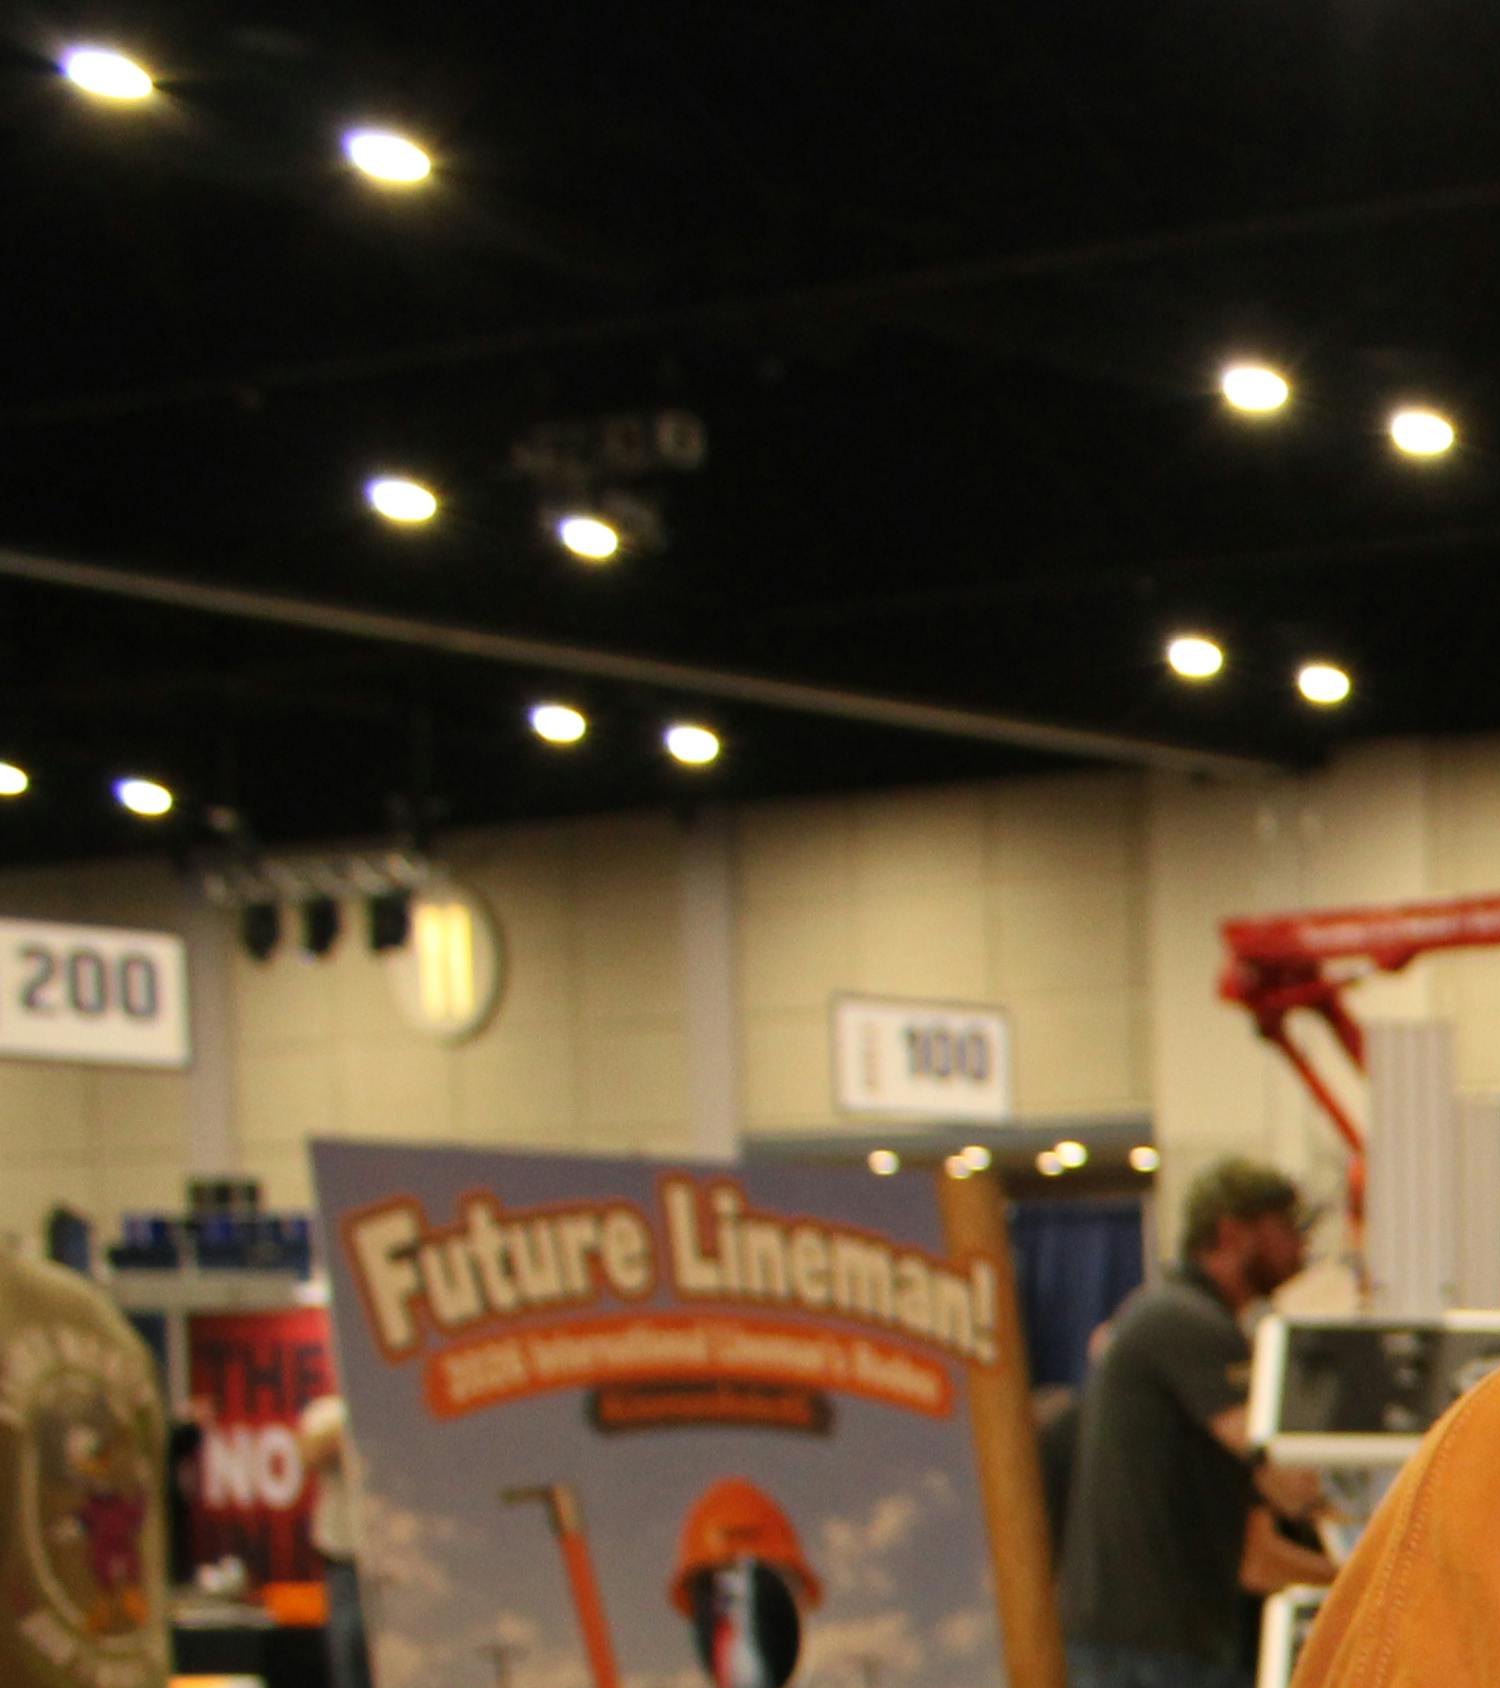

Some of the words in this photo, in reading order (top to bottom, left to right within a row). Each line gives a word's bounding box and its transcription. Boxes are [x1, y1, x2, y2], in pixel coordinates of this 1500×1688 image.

[18, 946, 159, 1018] 200
[903, 1024, 989, 1083] 100
[350, 1200, 651, 1350] Future
[661, 1178, 998, 1366] Lineman!
